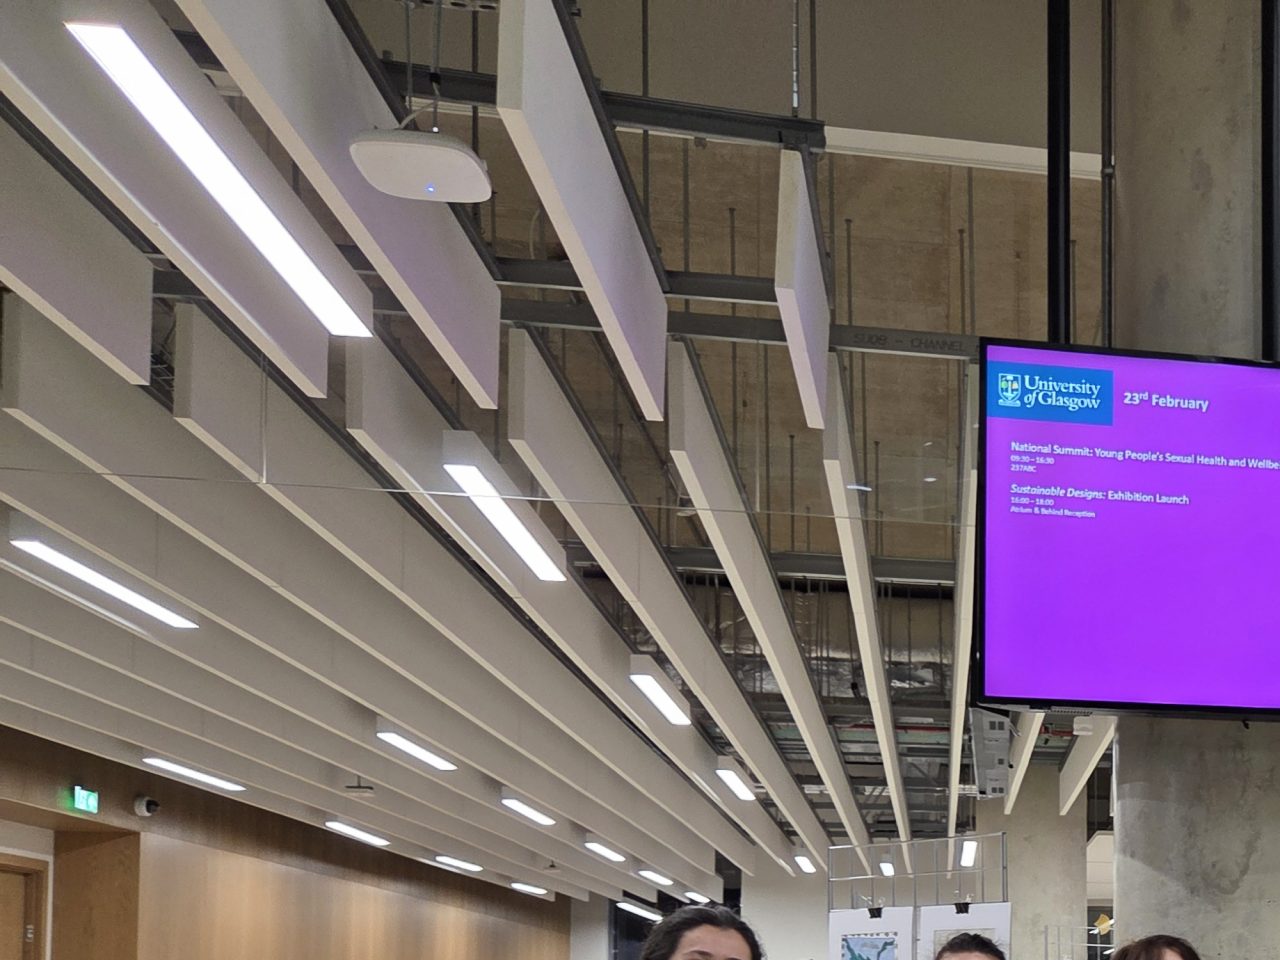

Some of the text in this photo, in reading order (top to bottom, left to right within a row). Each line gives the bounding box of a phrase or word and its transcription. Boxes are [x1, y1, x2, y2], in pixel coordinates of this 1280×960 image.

[1024, 374, 1101, 398] University
[1024, 390, 1101, 411] of Glasgow
[1123, 391, 1209, 412] 23rd February
[1011, 441, 1051, 454] National
[1053, 445, 1094, 457] Summit:
[1094, 447, 1124, 461] Young
[1125, 450, 1164, 463] People's
[1165, 452, 1195, 464] Sexual
[1196, 455, 1227, 467] Health
[1228, 457, 1247, 467] and
[1010, 483, 1190, 505] Sustainable Designs: Exhibition Launch
[1064, 509, 1096, 518] Reception
